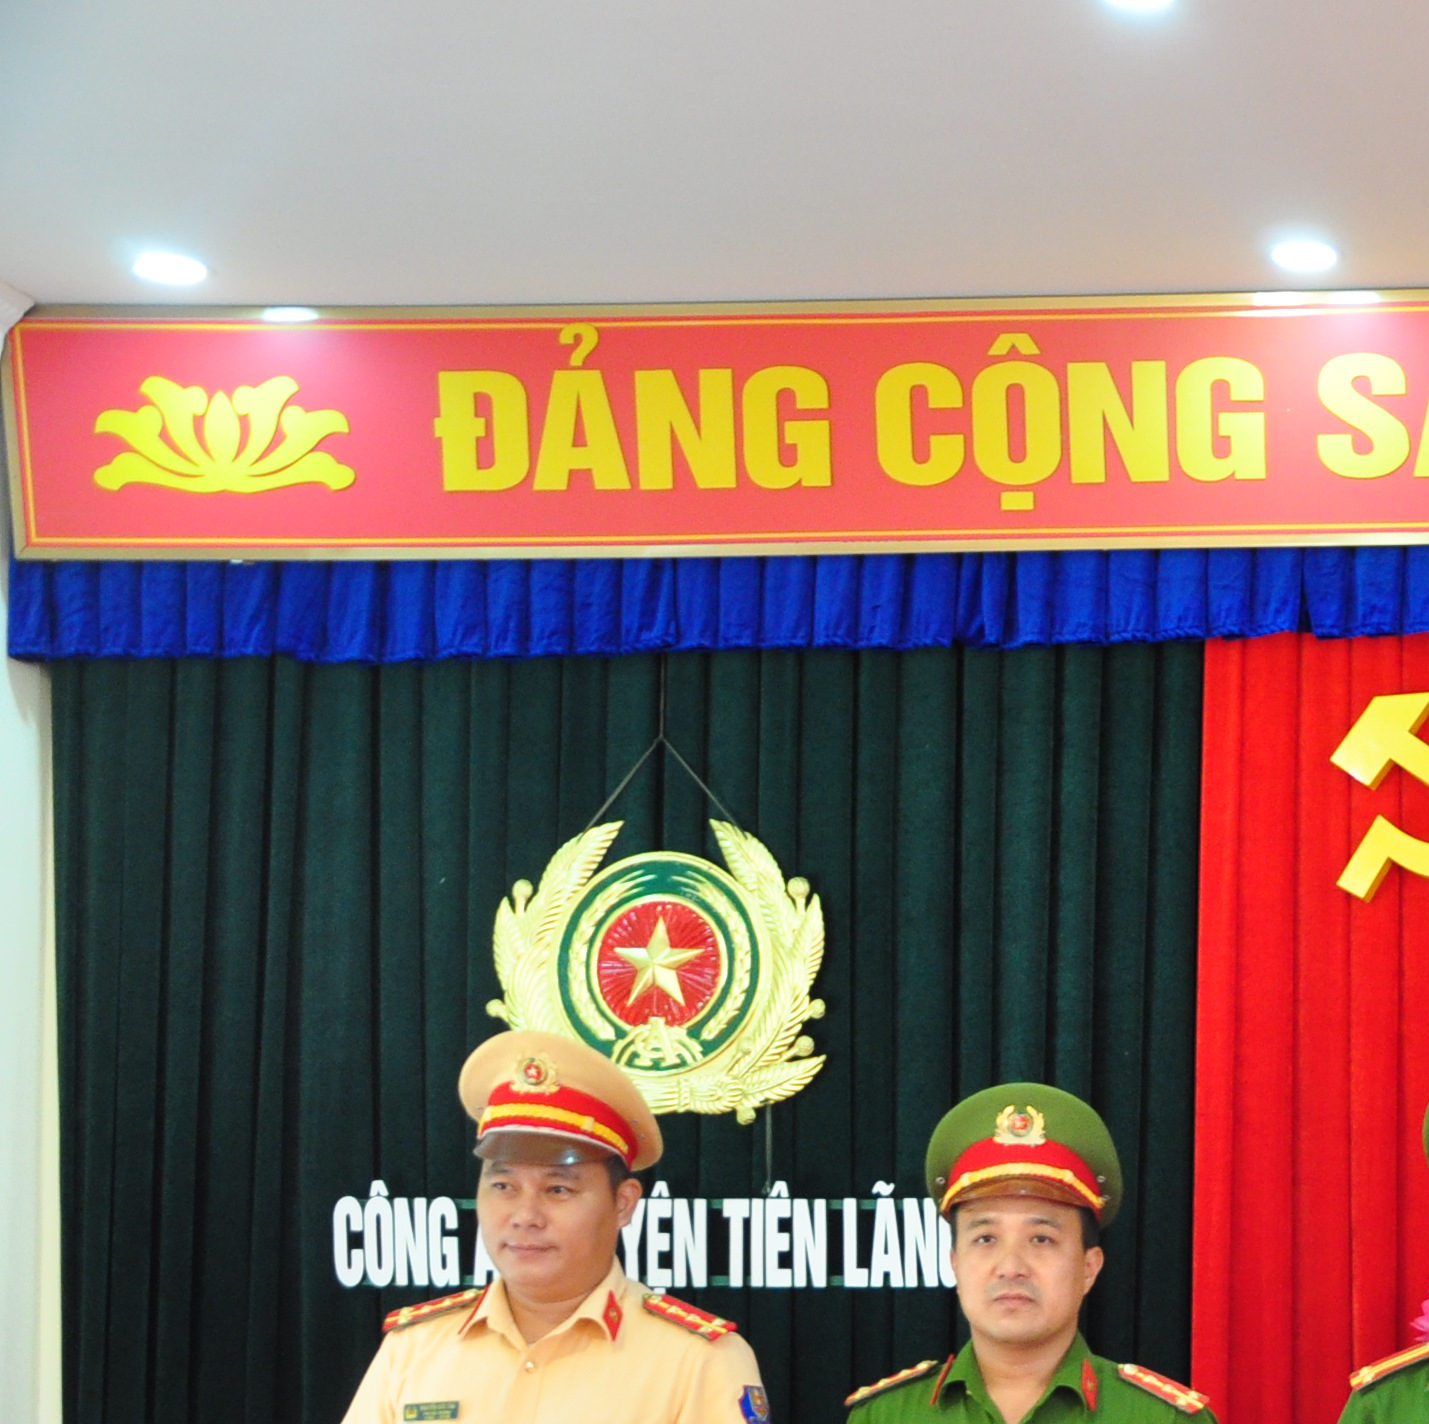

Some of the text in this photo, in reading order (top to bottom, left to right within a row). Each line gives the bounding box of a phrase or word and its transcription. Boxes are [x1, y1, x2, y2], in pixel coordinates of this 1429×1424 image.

[434, 323, 834, 491] ĐẢNG
[873, 334, 1268, 512] CỘNG
[333, 1179, 460, 1287] CÔNG
[622, 1180, 707, 1295] YỆN
[722, 1180, 827, 1288] TIÊN
